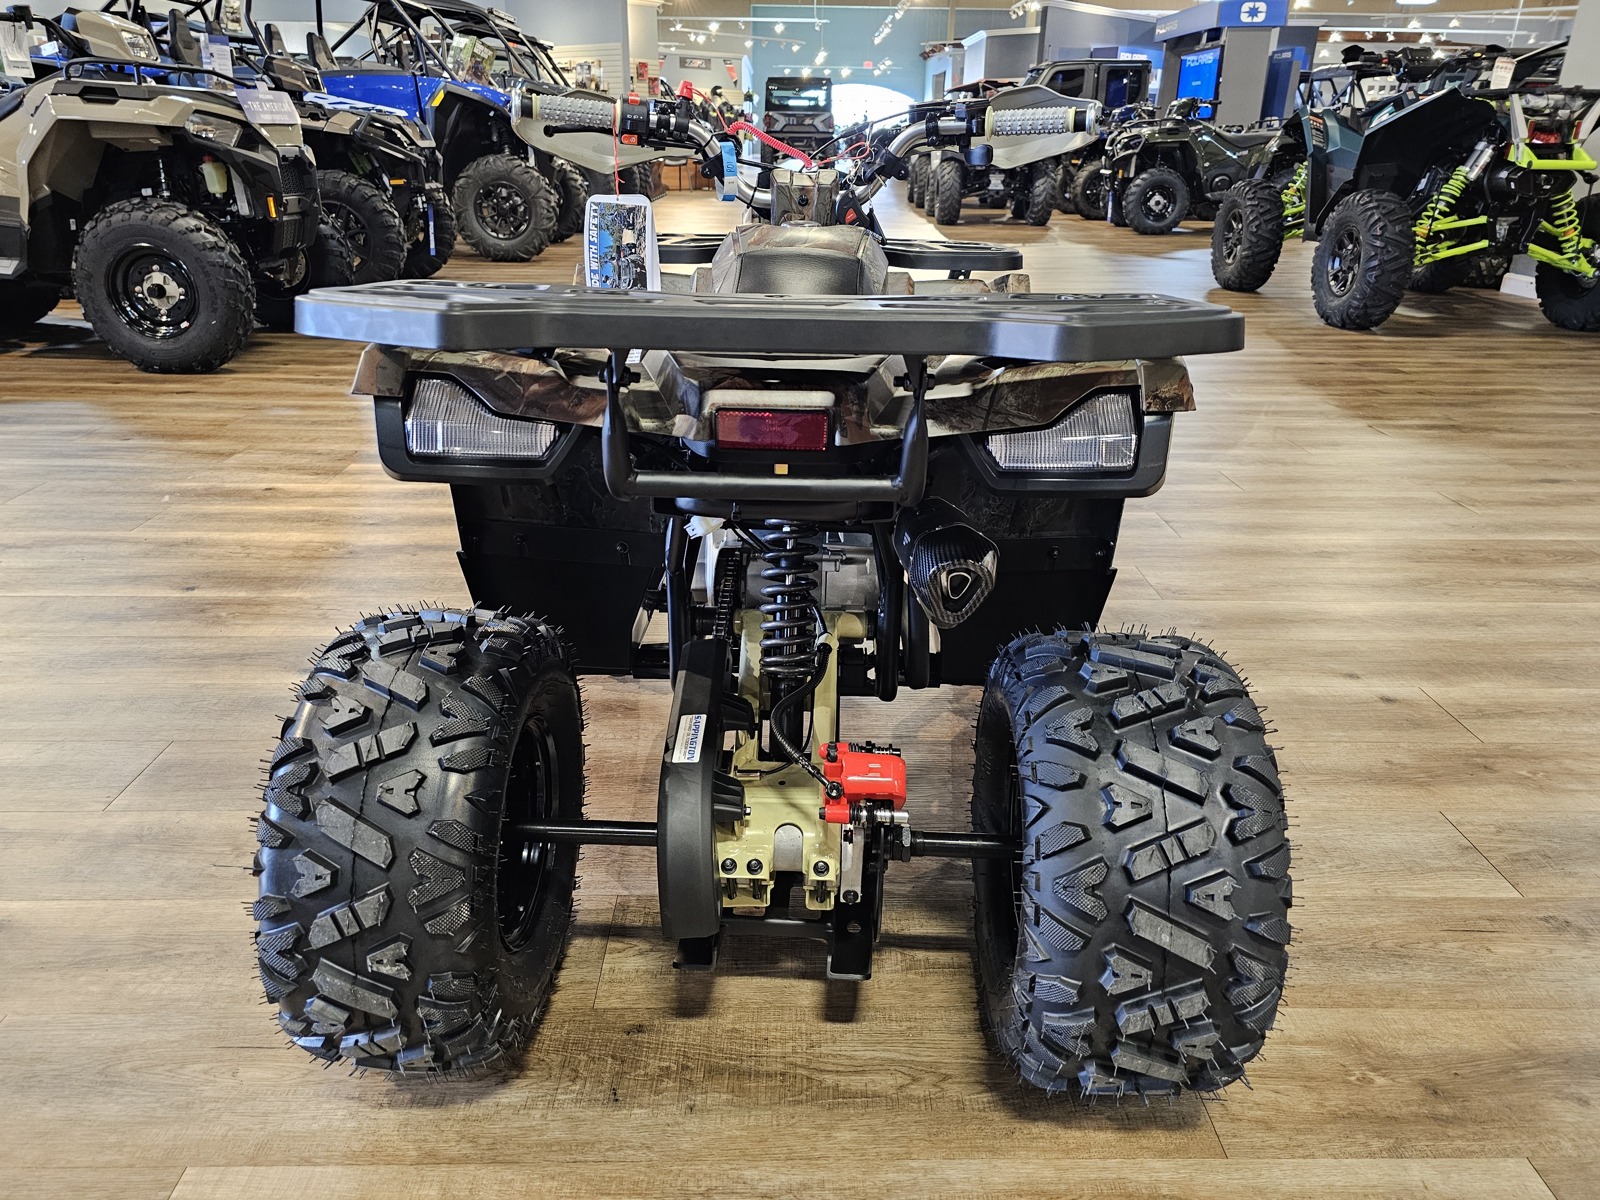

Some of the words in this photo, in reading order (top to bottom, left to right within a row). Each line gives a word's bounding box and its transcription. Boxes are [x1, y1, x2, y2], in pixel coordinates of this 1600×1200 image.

[1186, 52, 1214, 67] POLARIS
[248, 101, 262, 111] THE
[590, 203, 599, 243] SAFETY
[590, 245, 598, 269] WITH
[687, 715, 702, 761] SAPPINGTON
